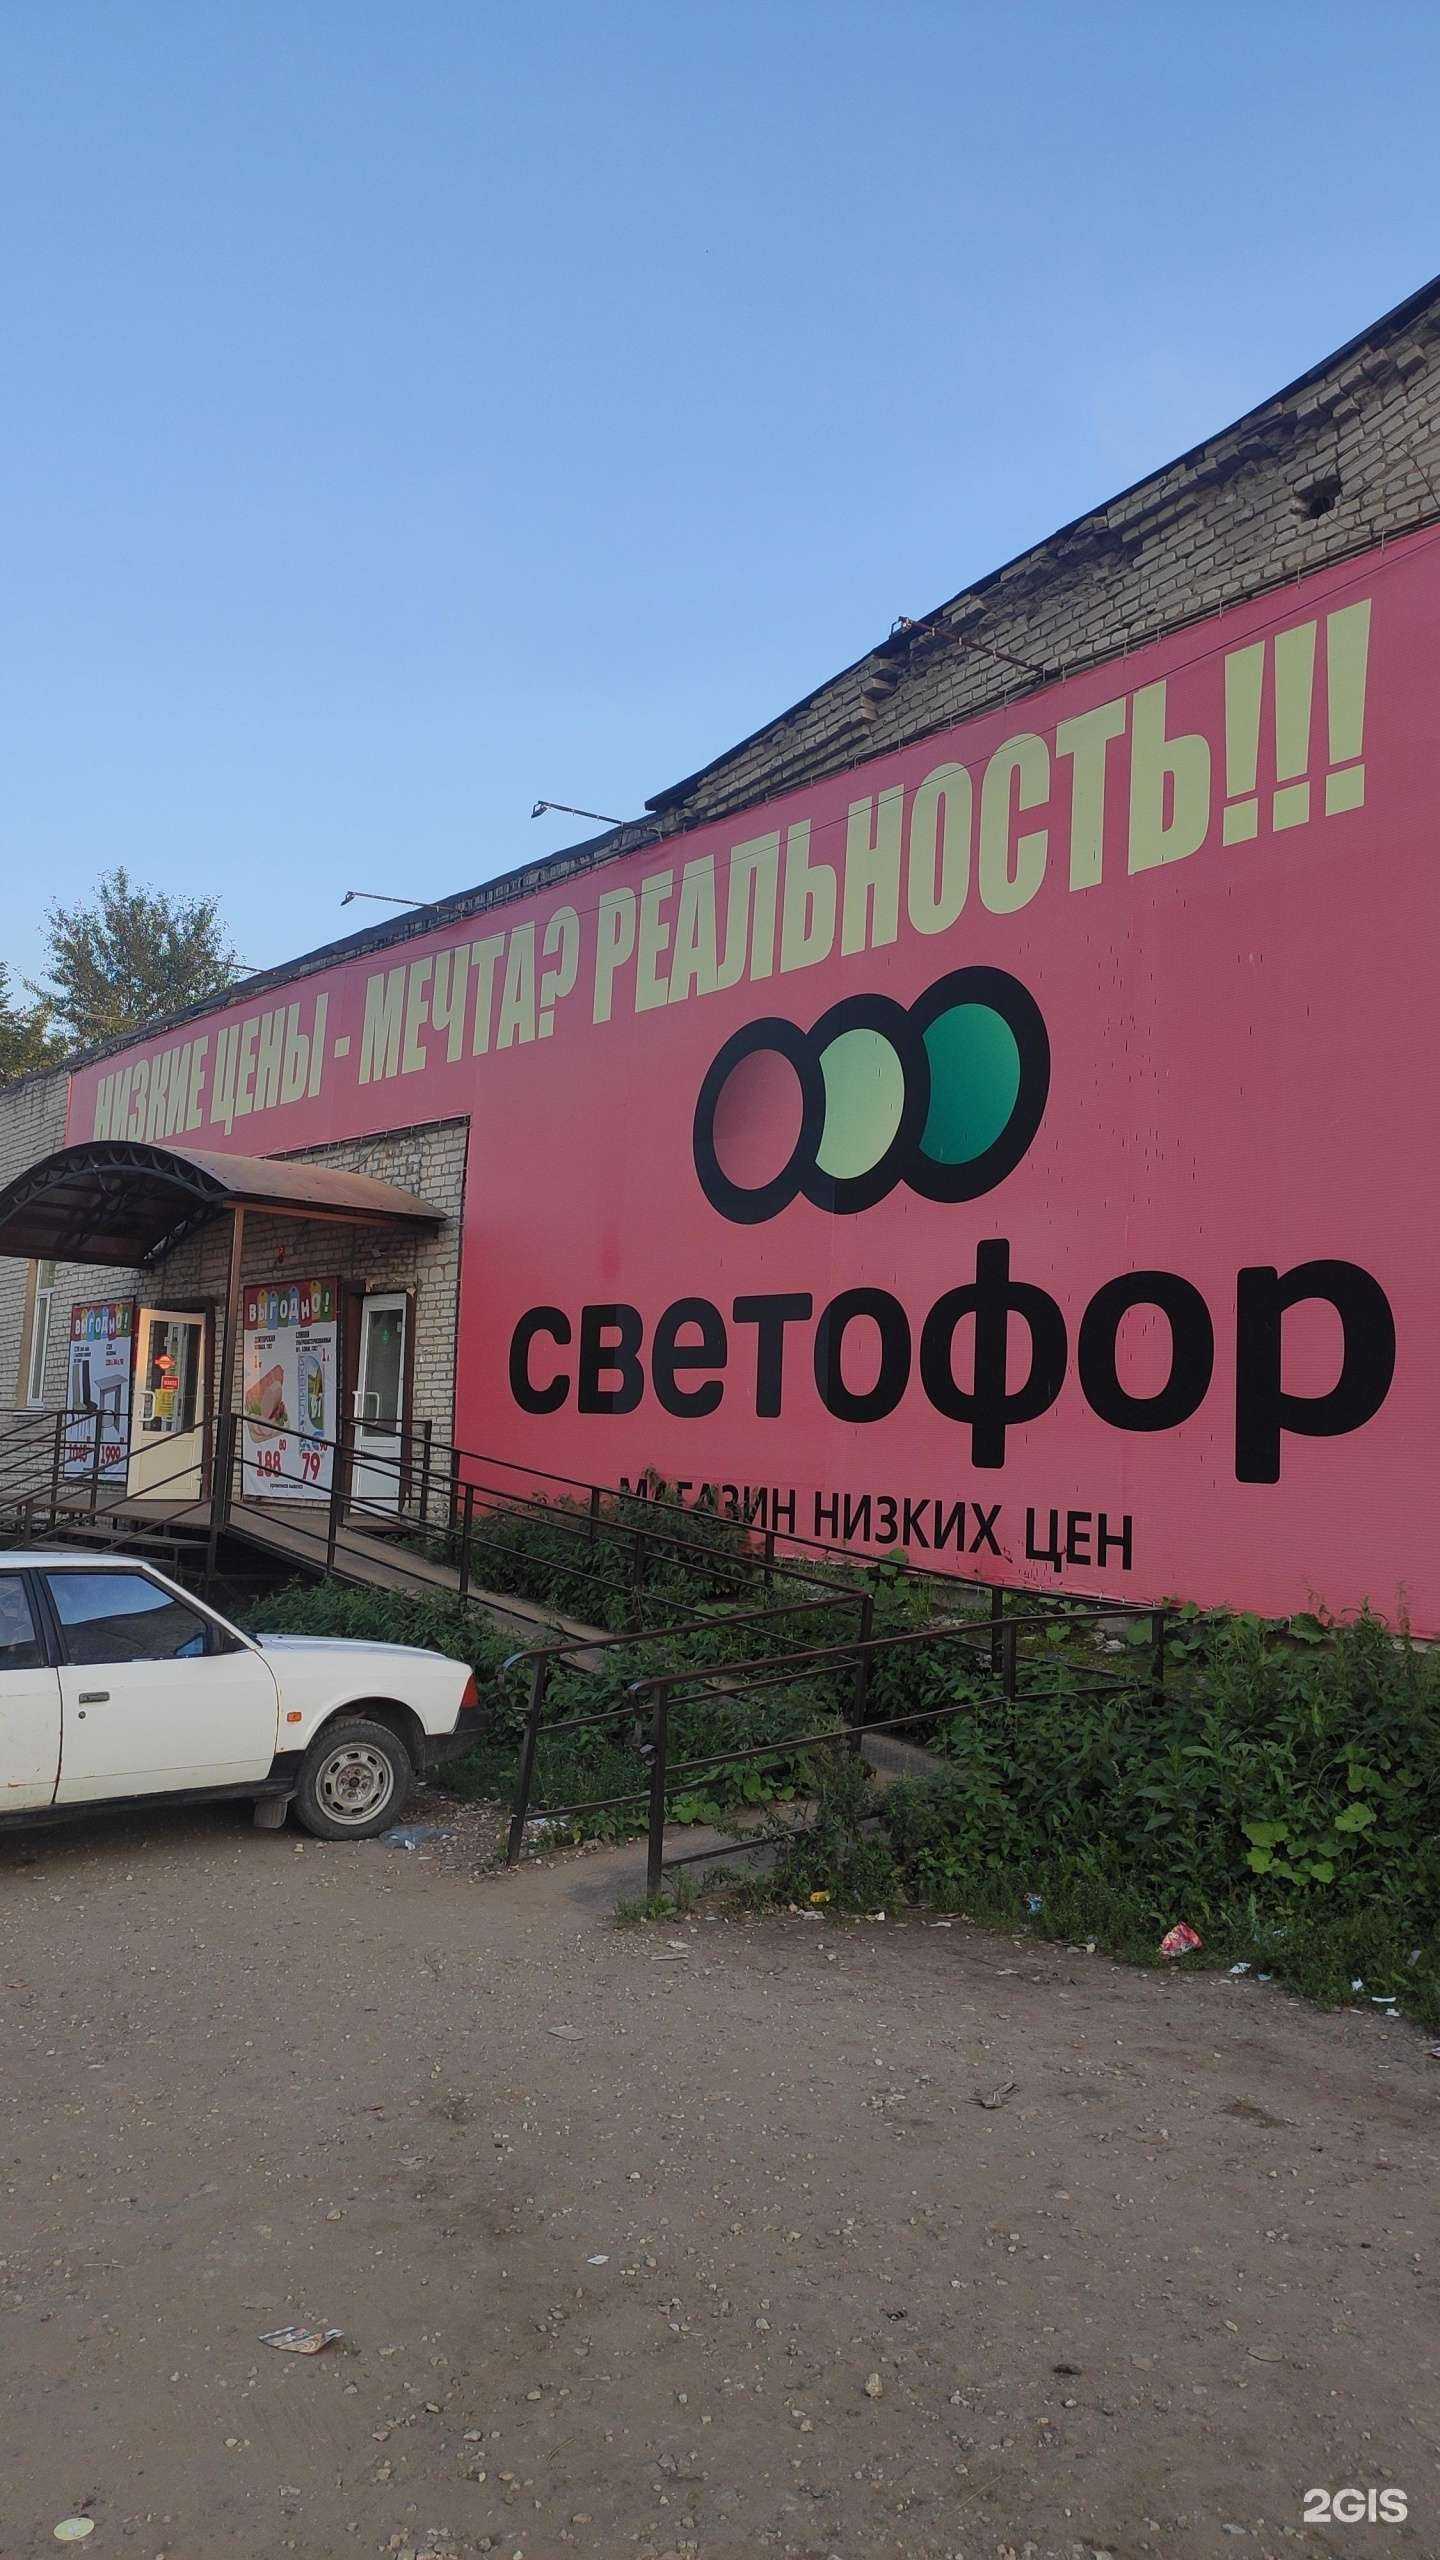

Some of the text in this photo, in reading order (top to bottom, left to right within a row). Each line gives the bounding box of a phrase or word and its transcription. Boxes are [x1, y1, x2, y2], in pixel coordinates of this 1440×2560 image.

[93, 598, 1372, 1144] НИЗКИЕ ЦЕНЫ - МЕЧТА? РЕАЛЬНОСТЬ!!!
[75, 1311, 129, 1335] ВЫГОДНО!
[248, 1291, 330, 1322] ВЫГОДНО!
[508, 1237, 1397, 1485] светофор
[302, 1452, 320, 1480] 79
[813, 1490, 1001, 1557] НИЗКИХ
[1023, 1507, 1134, 1574] ЦЕН
